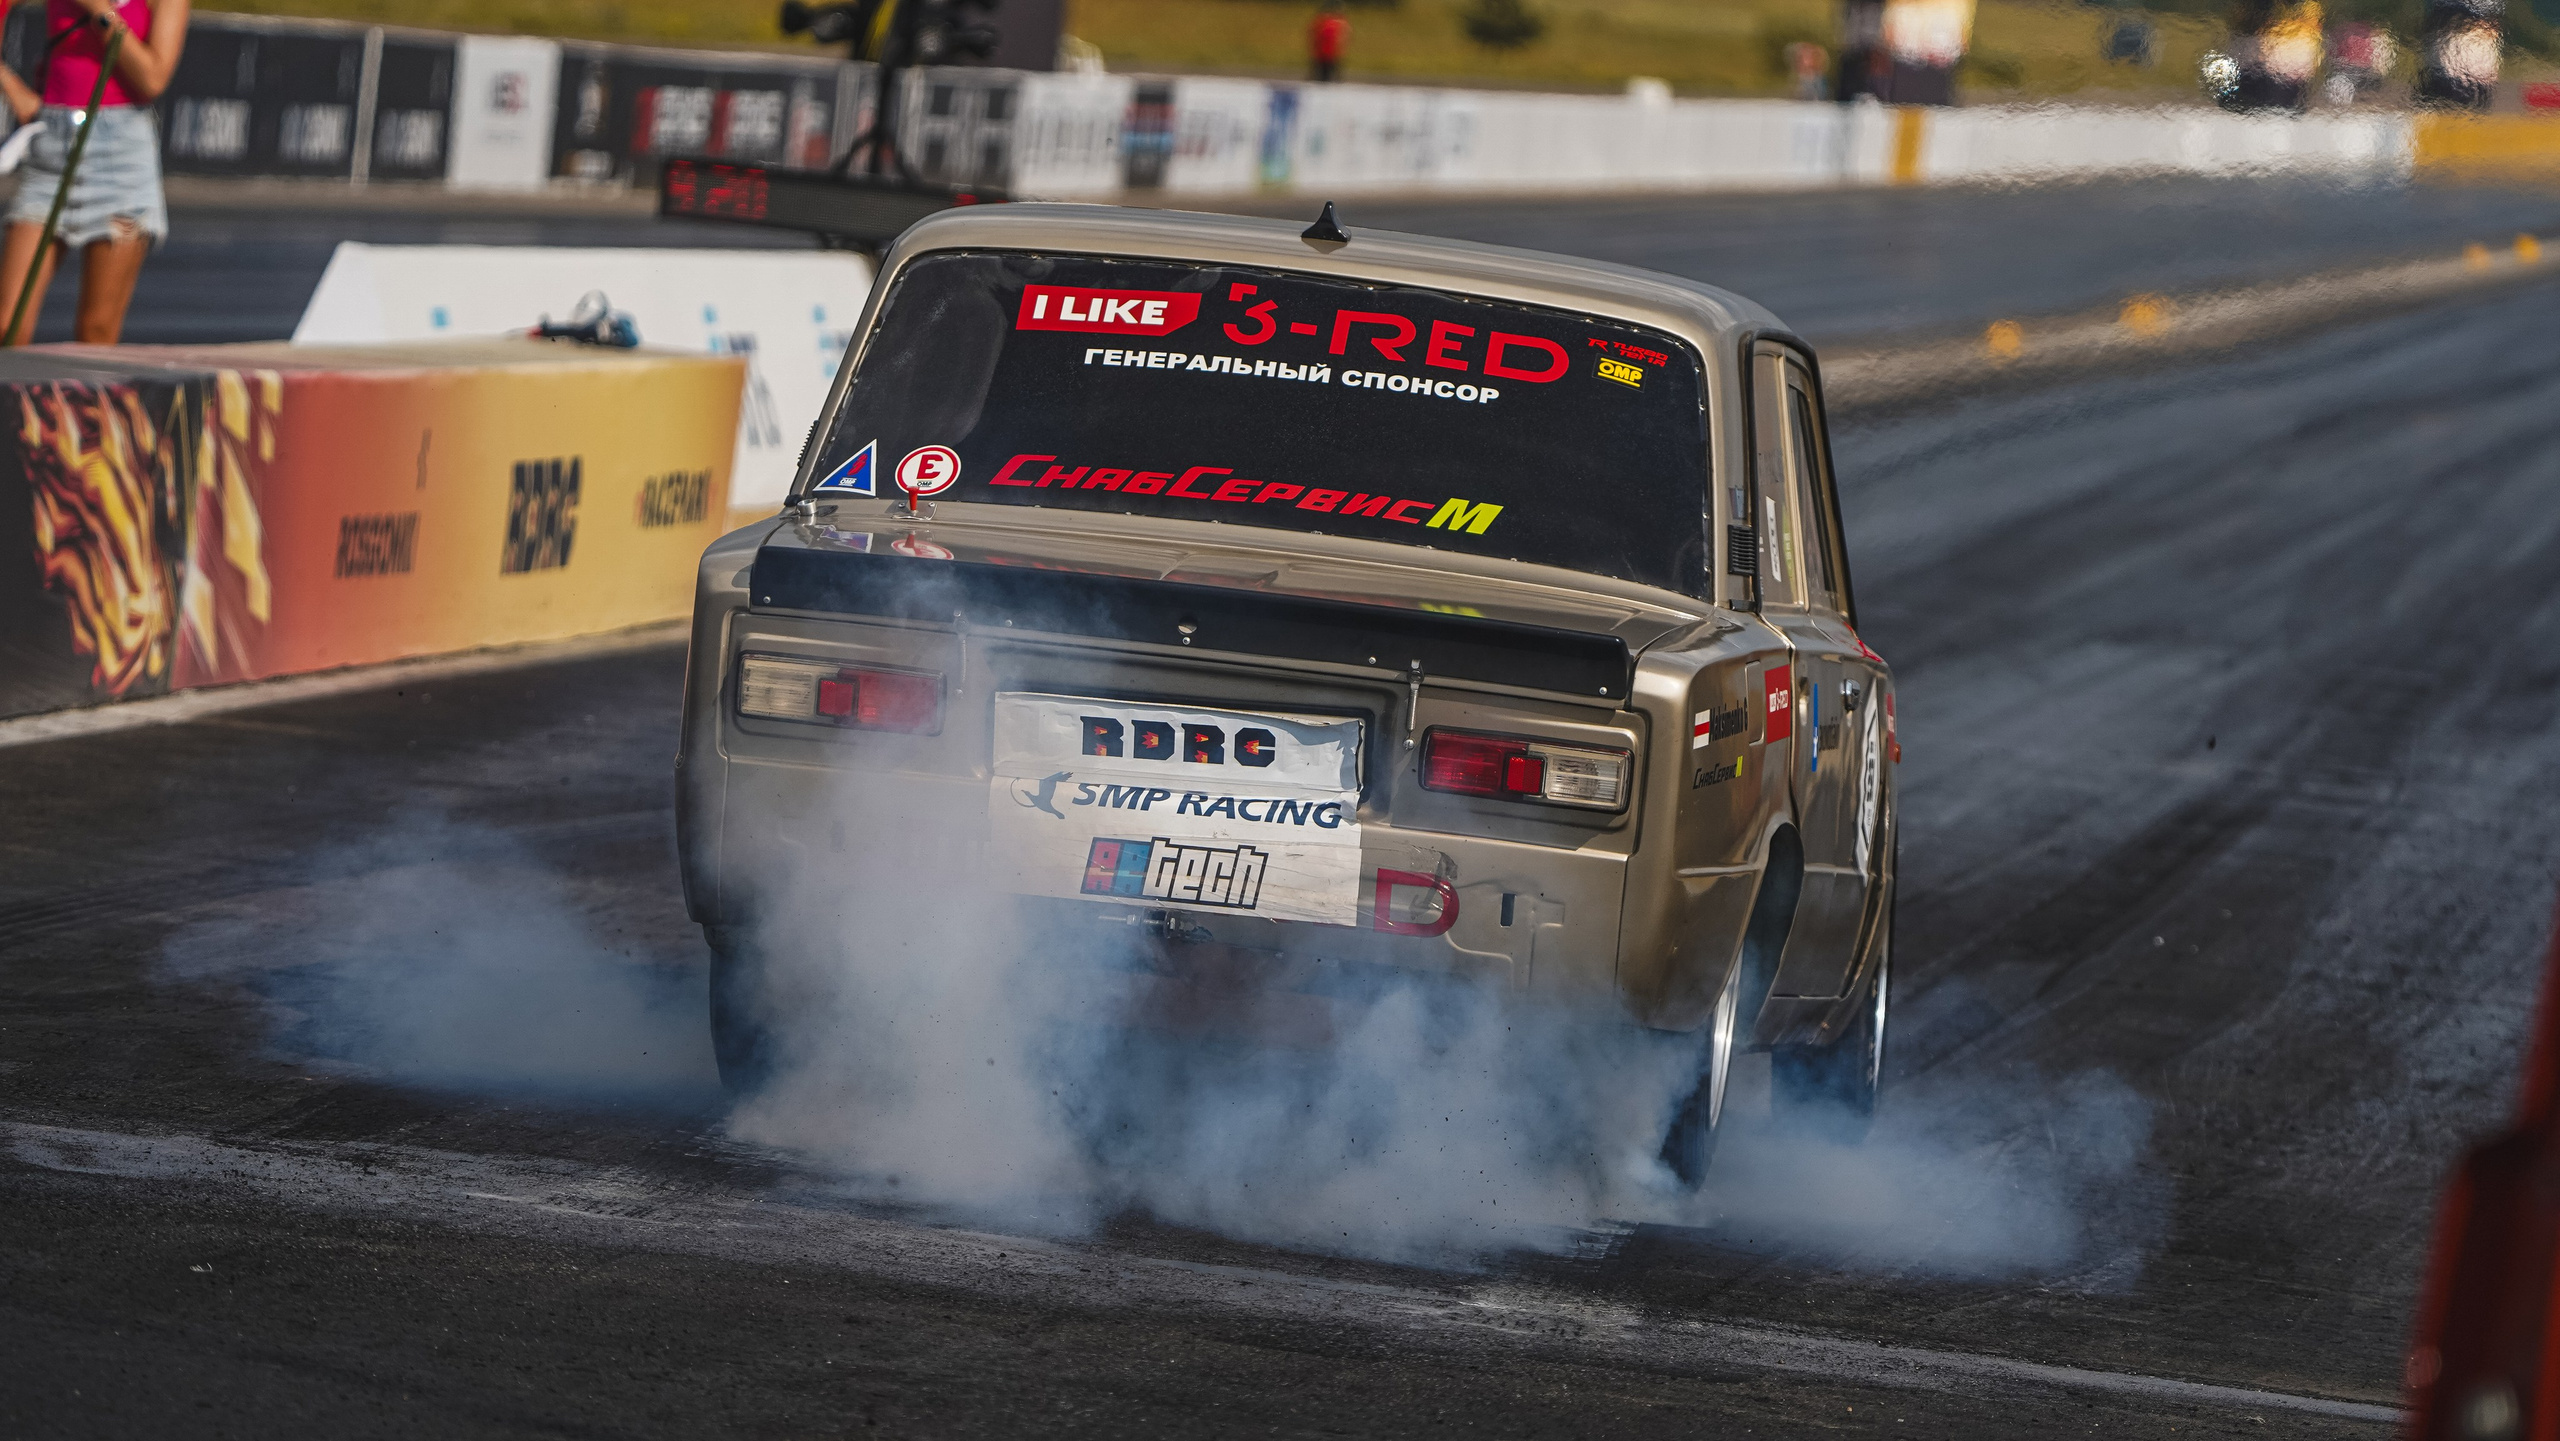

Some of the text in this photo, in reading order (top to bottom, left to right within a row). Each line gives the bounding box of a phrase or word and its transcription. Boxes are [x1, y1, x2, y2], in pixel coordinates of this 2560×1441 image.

[1032, 282, 1570, 384] I LIKE 3-RED
[1613, 341, 1669, 362] TURBO
[1083, 348, 1500, 404] ГЕНЕРАЛЬНЫЙ СПОНСОР
[1598, 361, 1643, 382] OMP
[916, 453, 944, 480] E
[1080, 716, 1276, 768] RDRC
[1072, 783, 1342, 829] SMP RACING
